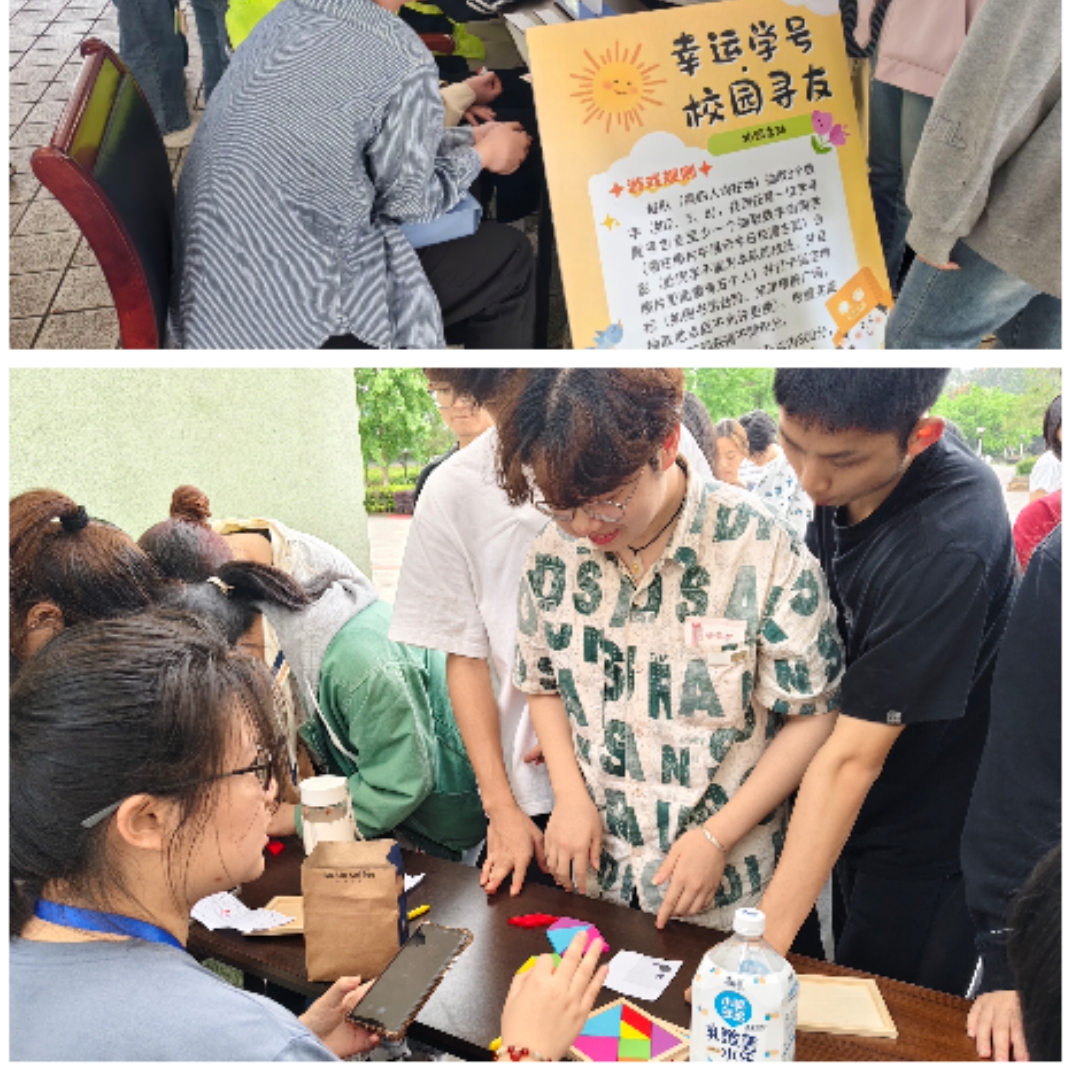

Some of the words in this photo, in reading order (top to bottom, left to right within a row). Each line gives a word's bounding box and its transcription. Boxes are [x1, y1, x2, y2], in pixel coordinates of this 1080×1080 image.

[671, 15, 813, 76] 幸运学号
[683, 64, 833, 128] 校园寻友
[627, 163, 698, 193] 游戏规则
